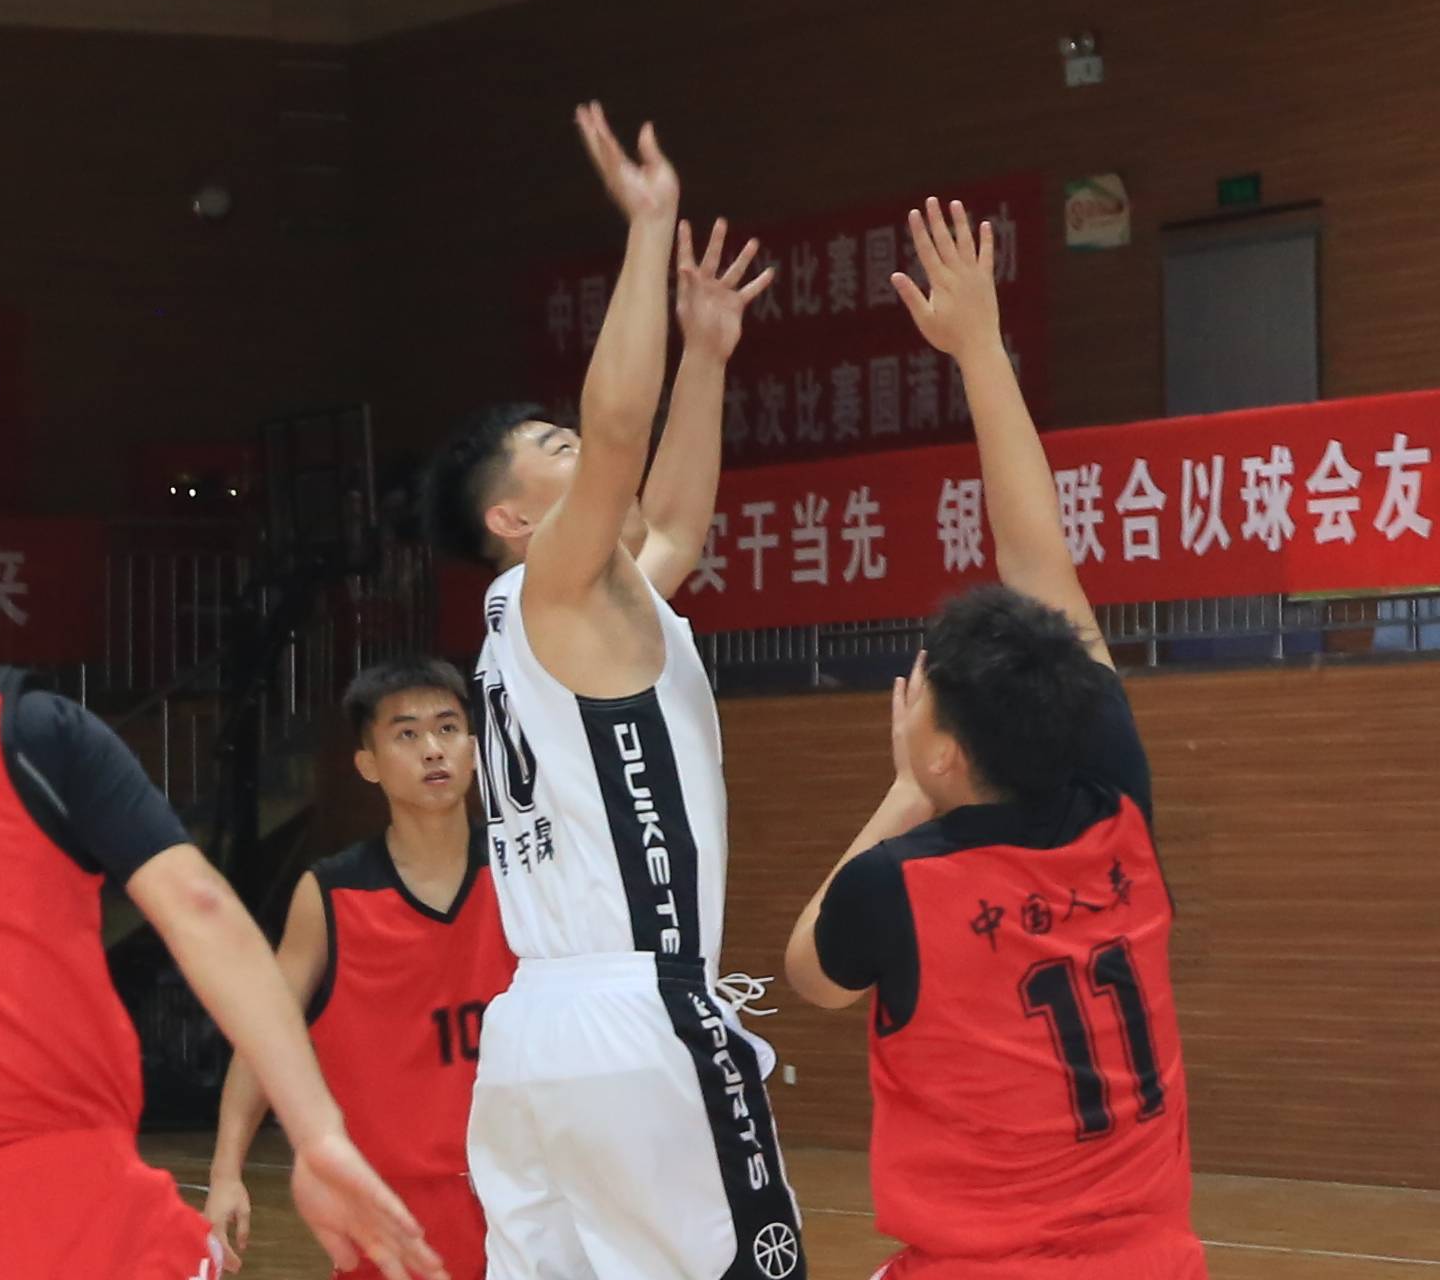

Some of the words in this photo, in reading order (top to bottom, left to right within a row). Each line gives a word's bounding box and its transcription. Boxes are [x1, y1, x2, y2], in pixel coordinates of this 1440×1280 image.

[935, 431, 1434, 574] 银联合以球会友
[970, 859, 1136, 953] 中国人寿
[1018, 936, 1166, 1143] 11
